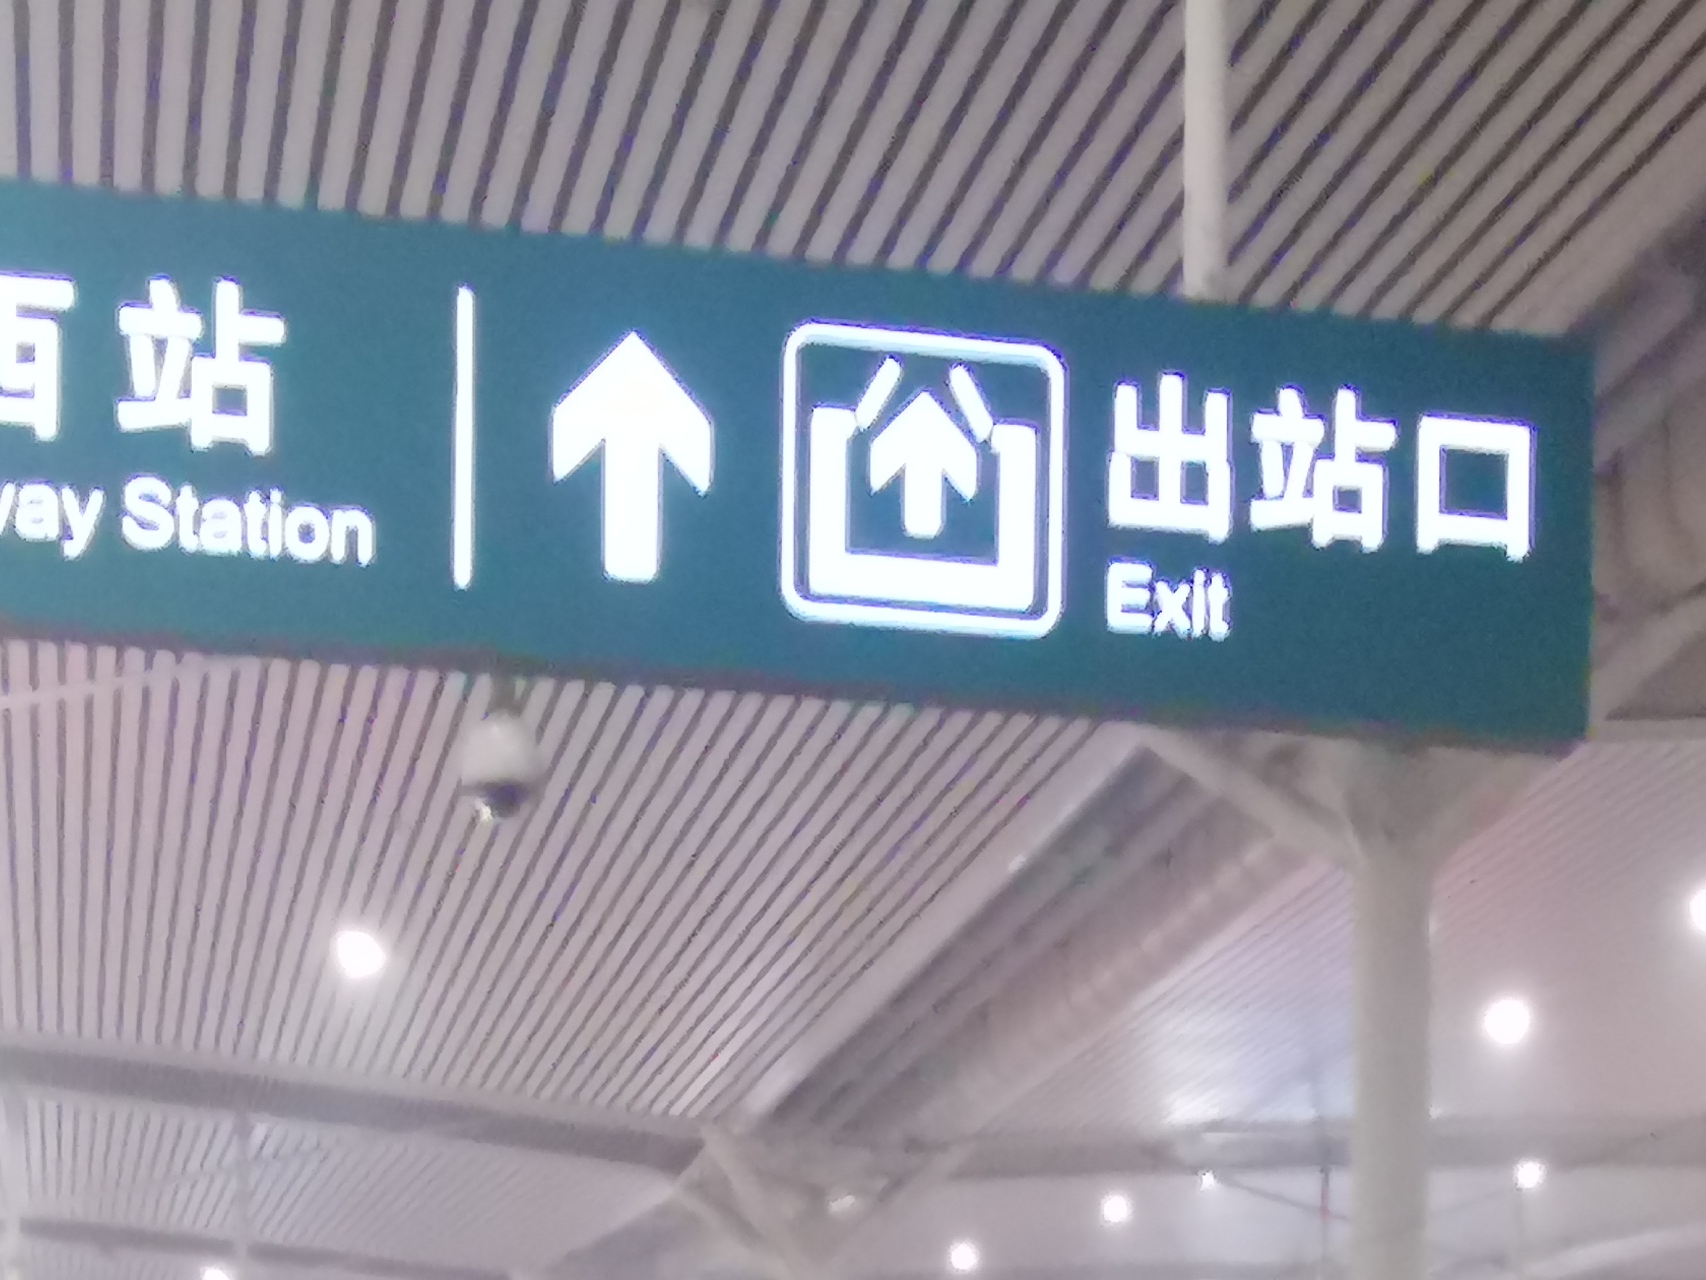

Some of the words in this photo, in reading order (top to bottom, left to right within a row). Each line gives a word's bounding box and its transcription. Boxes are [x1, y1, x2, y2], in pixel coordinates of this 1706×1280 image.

[1106, 373, 1531, 561] 出站口
[121, 475, 375, 566] Station
[1106, 562, 1230, 639] Exit
